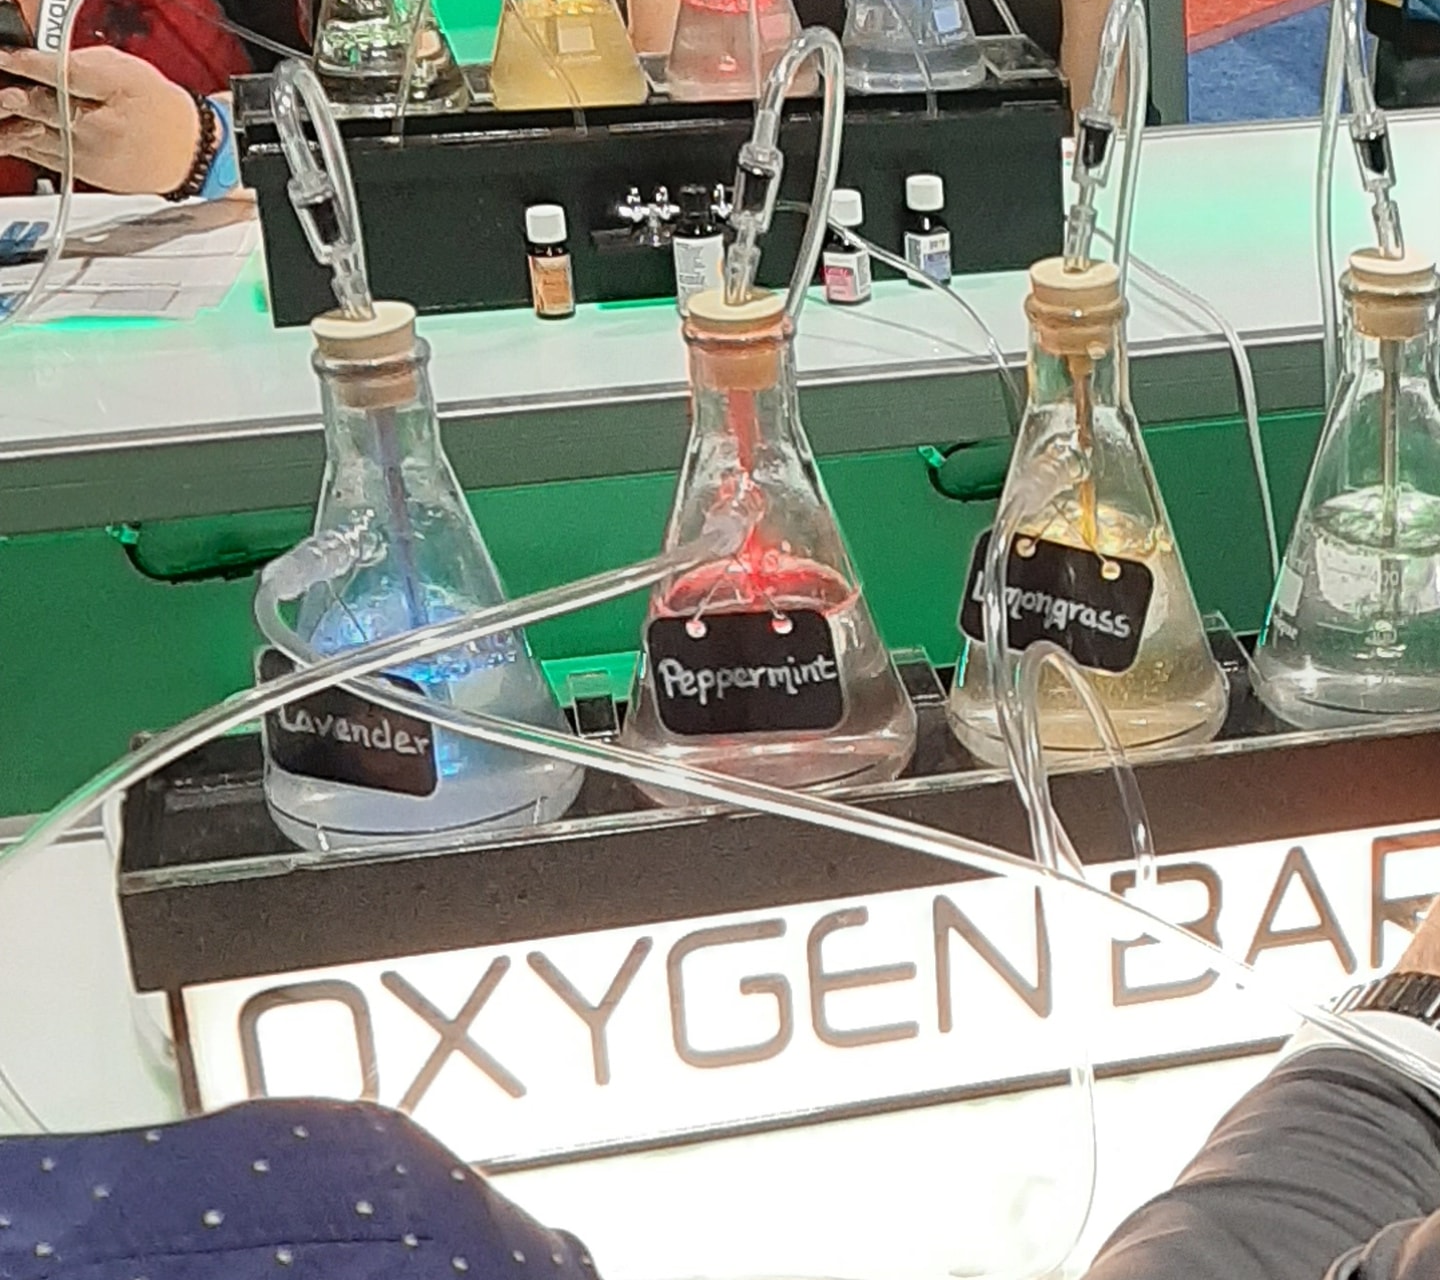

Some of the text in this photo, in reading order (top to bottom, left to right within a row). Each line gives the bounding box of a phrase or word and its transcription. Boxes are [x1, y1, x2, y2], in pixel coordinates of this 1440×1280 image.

[972, 570, 1131, 639] Lmongrass
[658, 654, 837, 706] Peppermint
[278, 703, 430, 755] Lavender
[238, 884, 1053, 1115] OXYGEN
